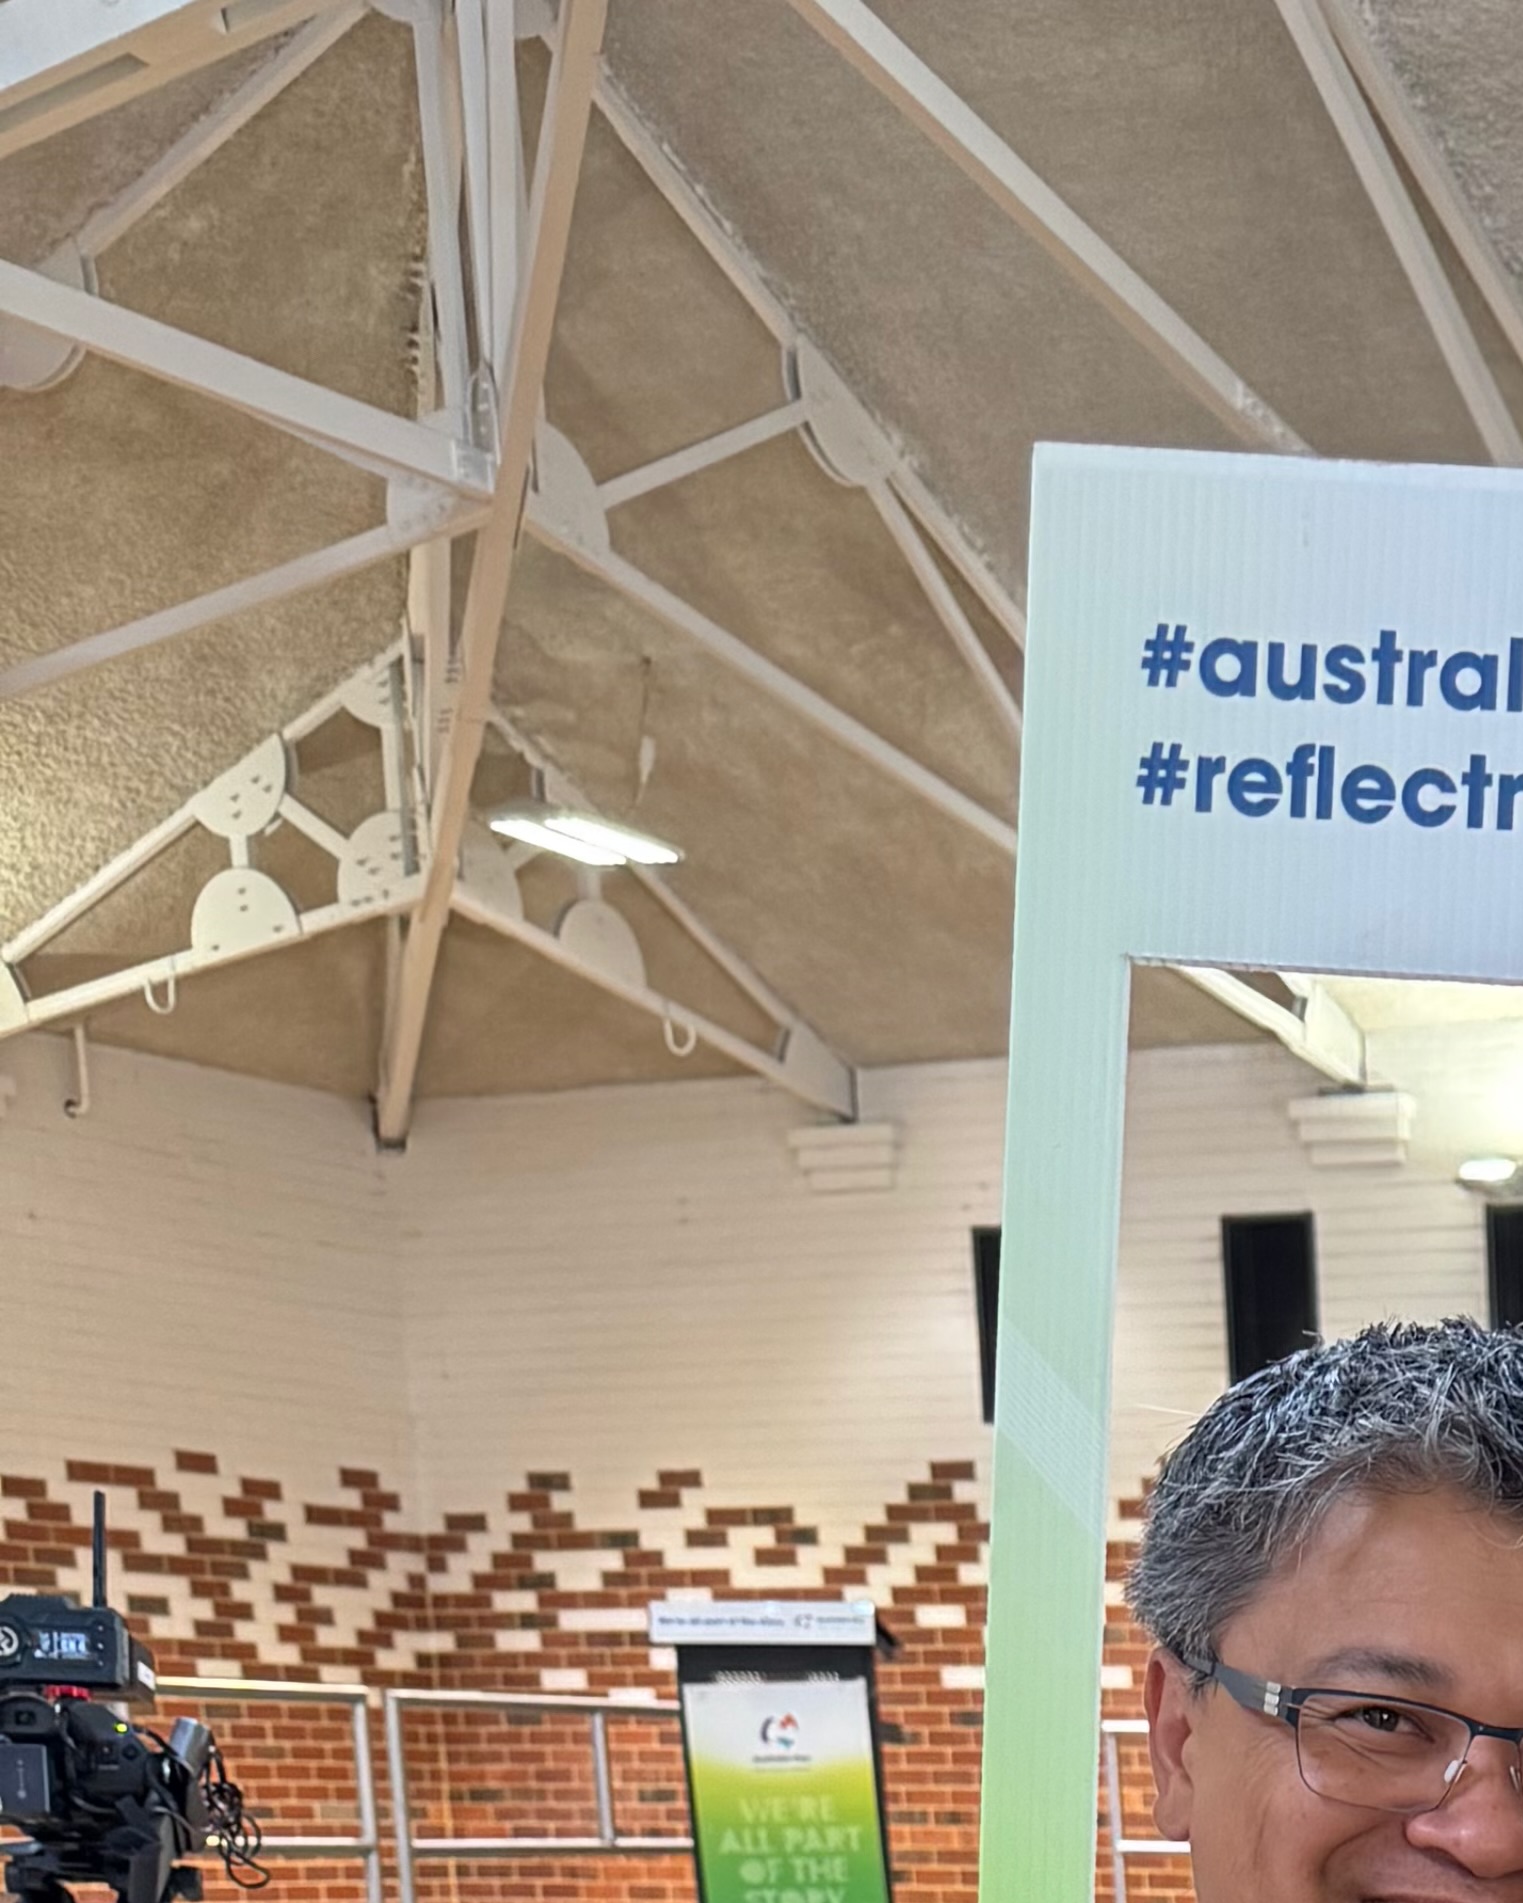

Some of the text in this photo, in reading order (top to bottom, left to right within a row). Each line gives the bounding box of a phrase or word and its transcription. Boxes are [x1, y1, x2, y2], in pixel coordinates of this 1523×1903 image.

[720, 1825, 863, 1854] ALL PART
[738, 1856, 849, 1884] OF THE
